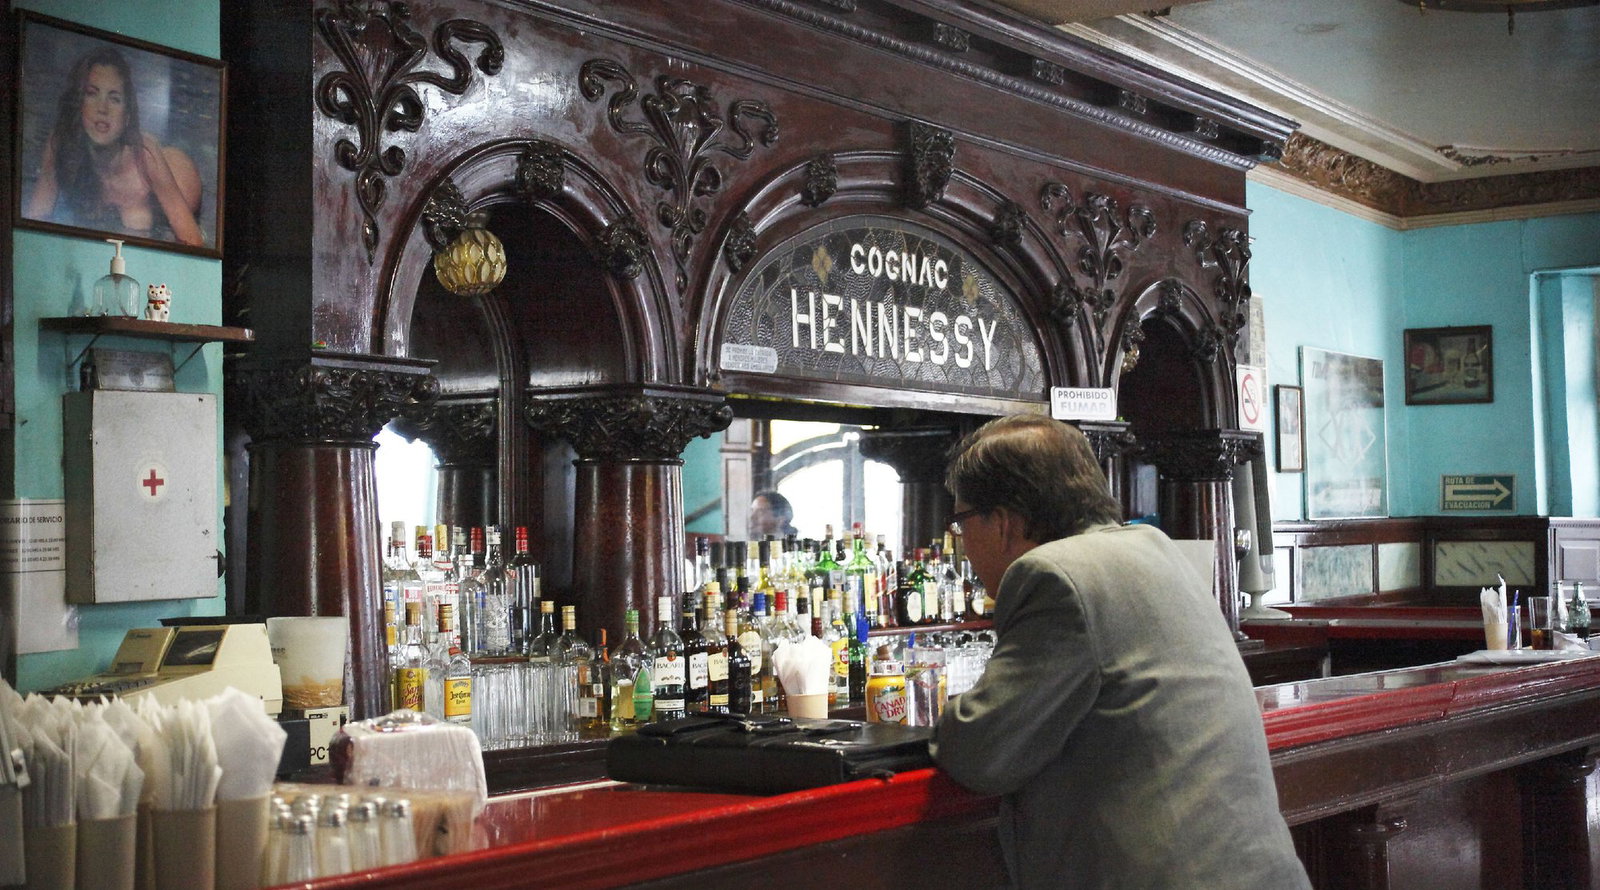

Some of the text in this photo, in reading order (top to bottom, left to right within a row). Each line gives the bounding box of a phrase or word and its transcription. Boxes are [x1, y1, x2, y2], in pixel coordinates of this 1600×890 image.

[850, 243, 948, 290] COGNAC
[790, 288, 997, 371] HENNESSY
[1058, 390, 1108, 400] PROHIBIDO
[1060, 401, 1107, 413] FUMAR
[1445, 476, 1475, 485] RUTA DE
[874, 696, 907, 714] CANAD
[885, 704, 906, 719] DRY
